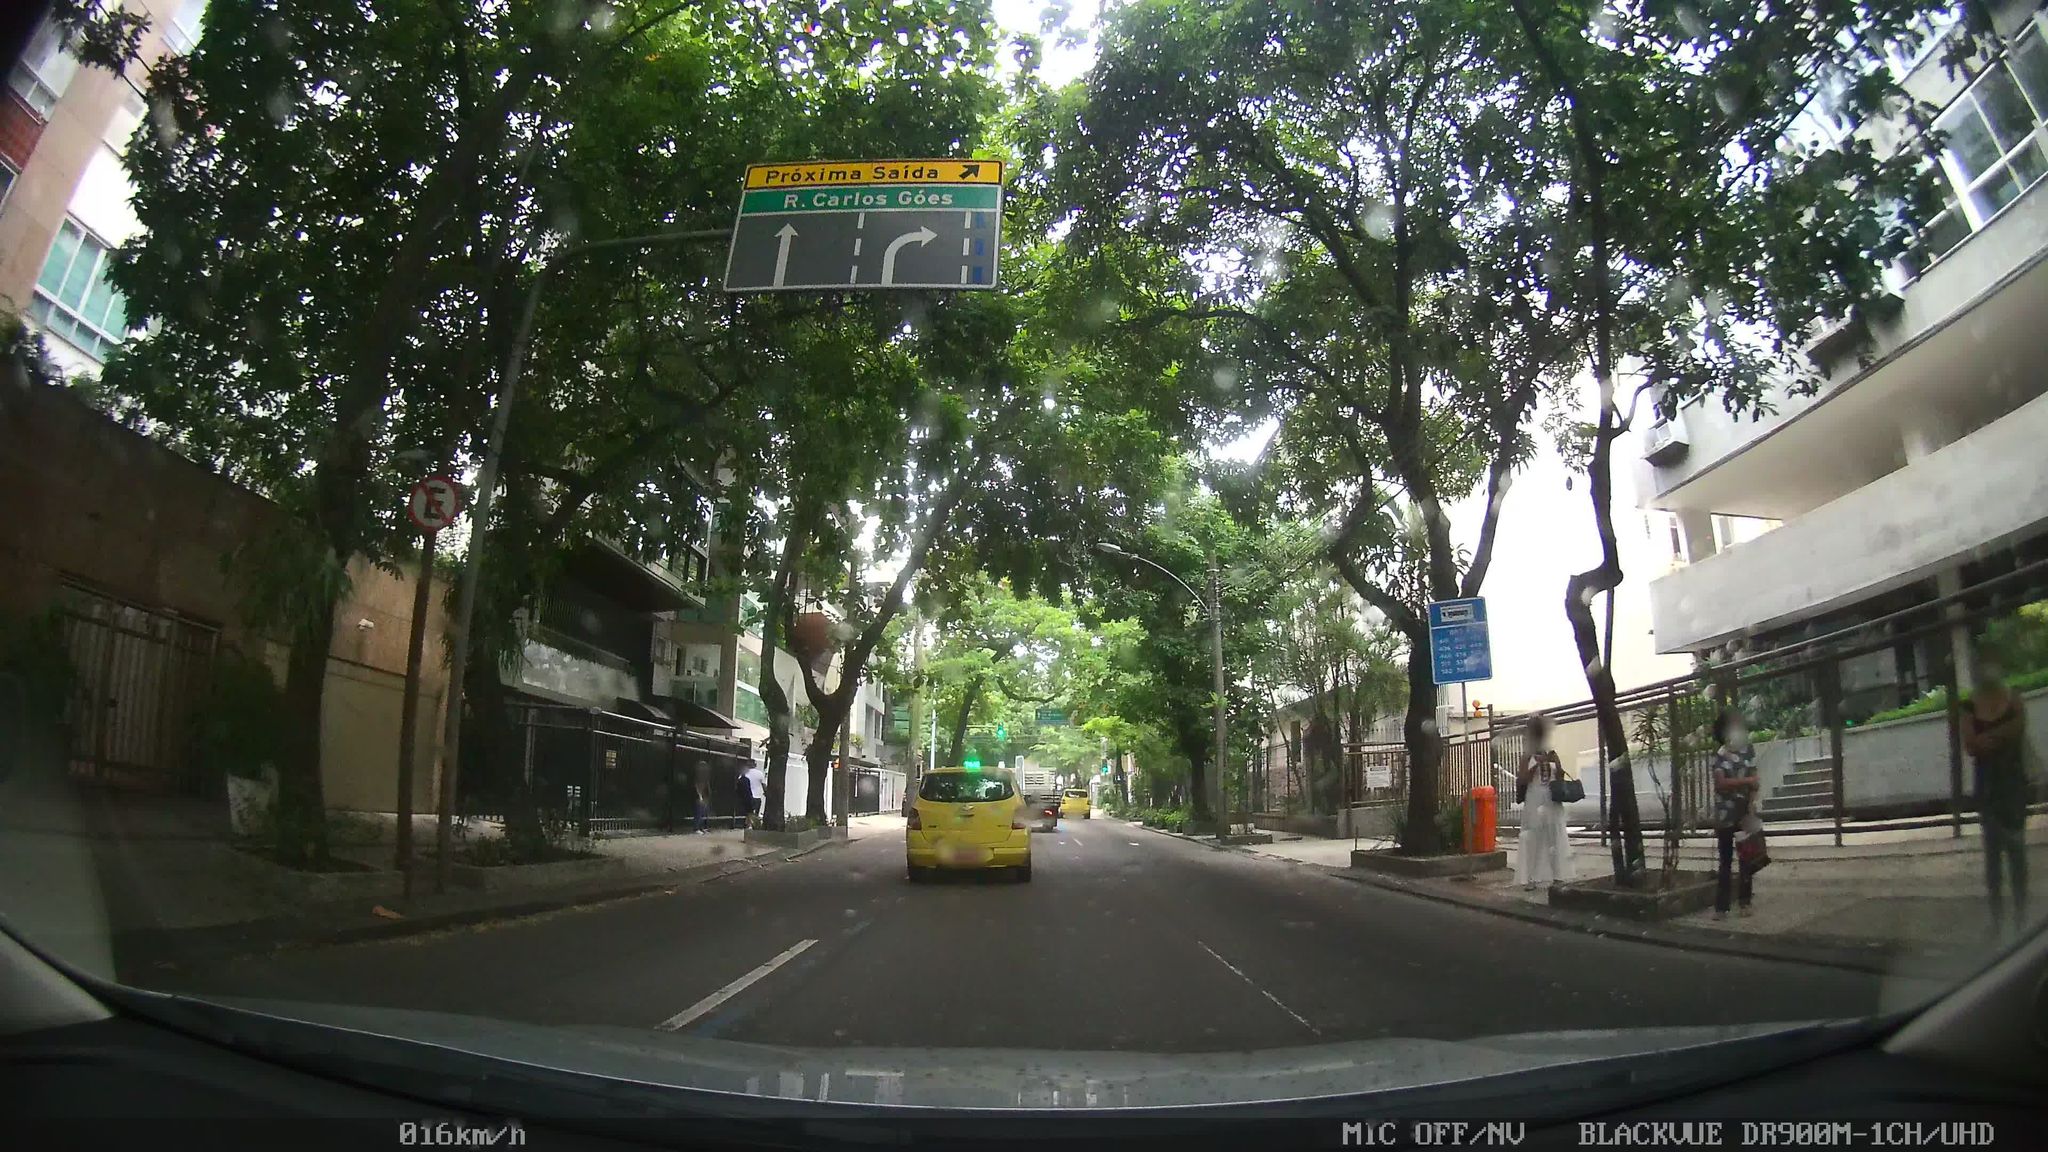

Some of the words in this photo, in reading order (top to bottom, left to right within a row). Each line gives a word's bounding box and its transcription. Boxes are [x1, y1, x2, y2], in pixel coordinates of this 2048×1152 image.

[765, 168, 862, 184] Próxima
[873, 164, 939, 179] Saída
[783, 194, 806, 208] R.
[812, 191, 888, 207] Carlos
[898, 189, 953, 205] Góes
